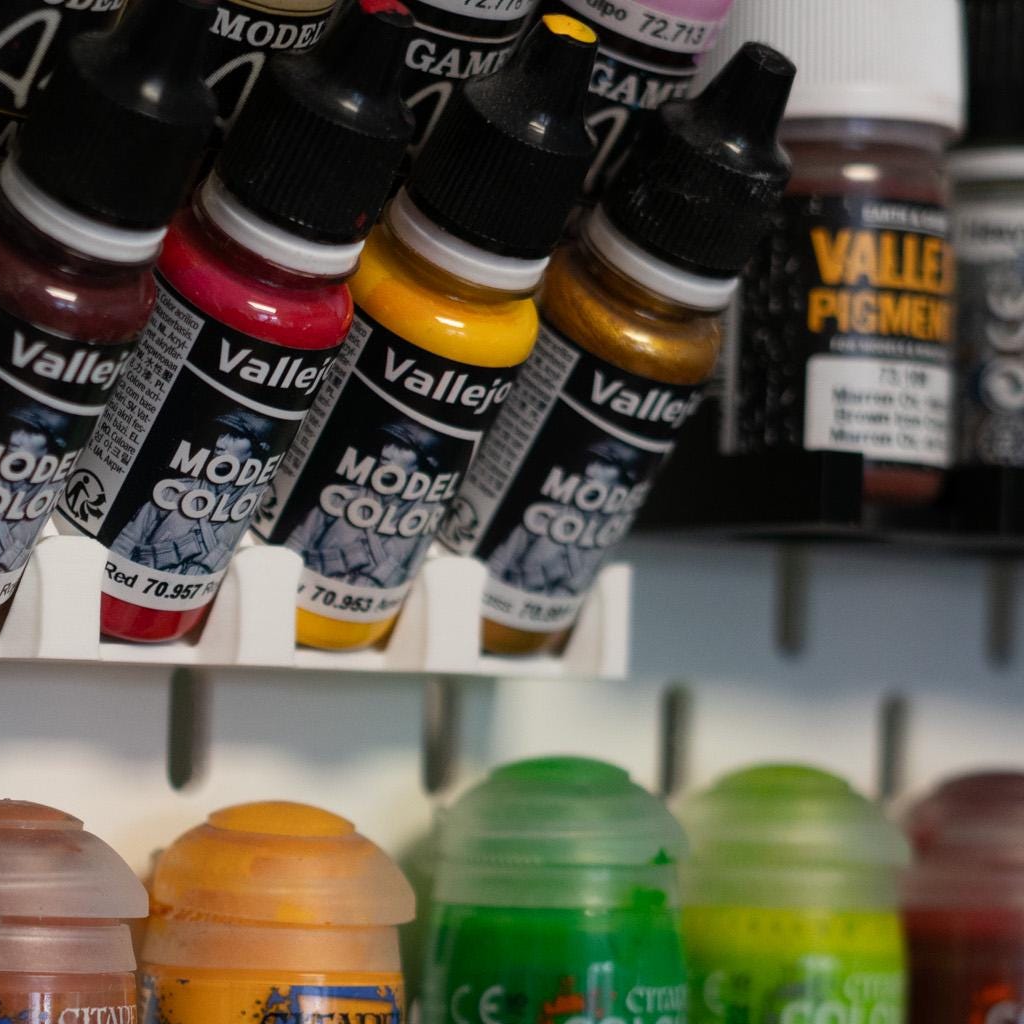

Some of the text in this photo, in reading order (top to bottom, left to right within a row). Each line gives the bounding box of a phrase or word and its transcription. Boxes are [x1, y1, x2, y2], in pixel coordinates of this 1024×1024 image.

[209, 7, 326, 49] MODEL
[384, 347, 512, 415] Vallejo
[336, 447, 461, 501] MODEL
[104, 560, 204, 600] Red 70.957
[310, 585, 373, 612] 70.953
